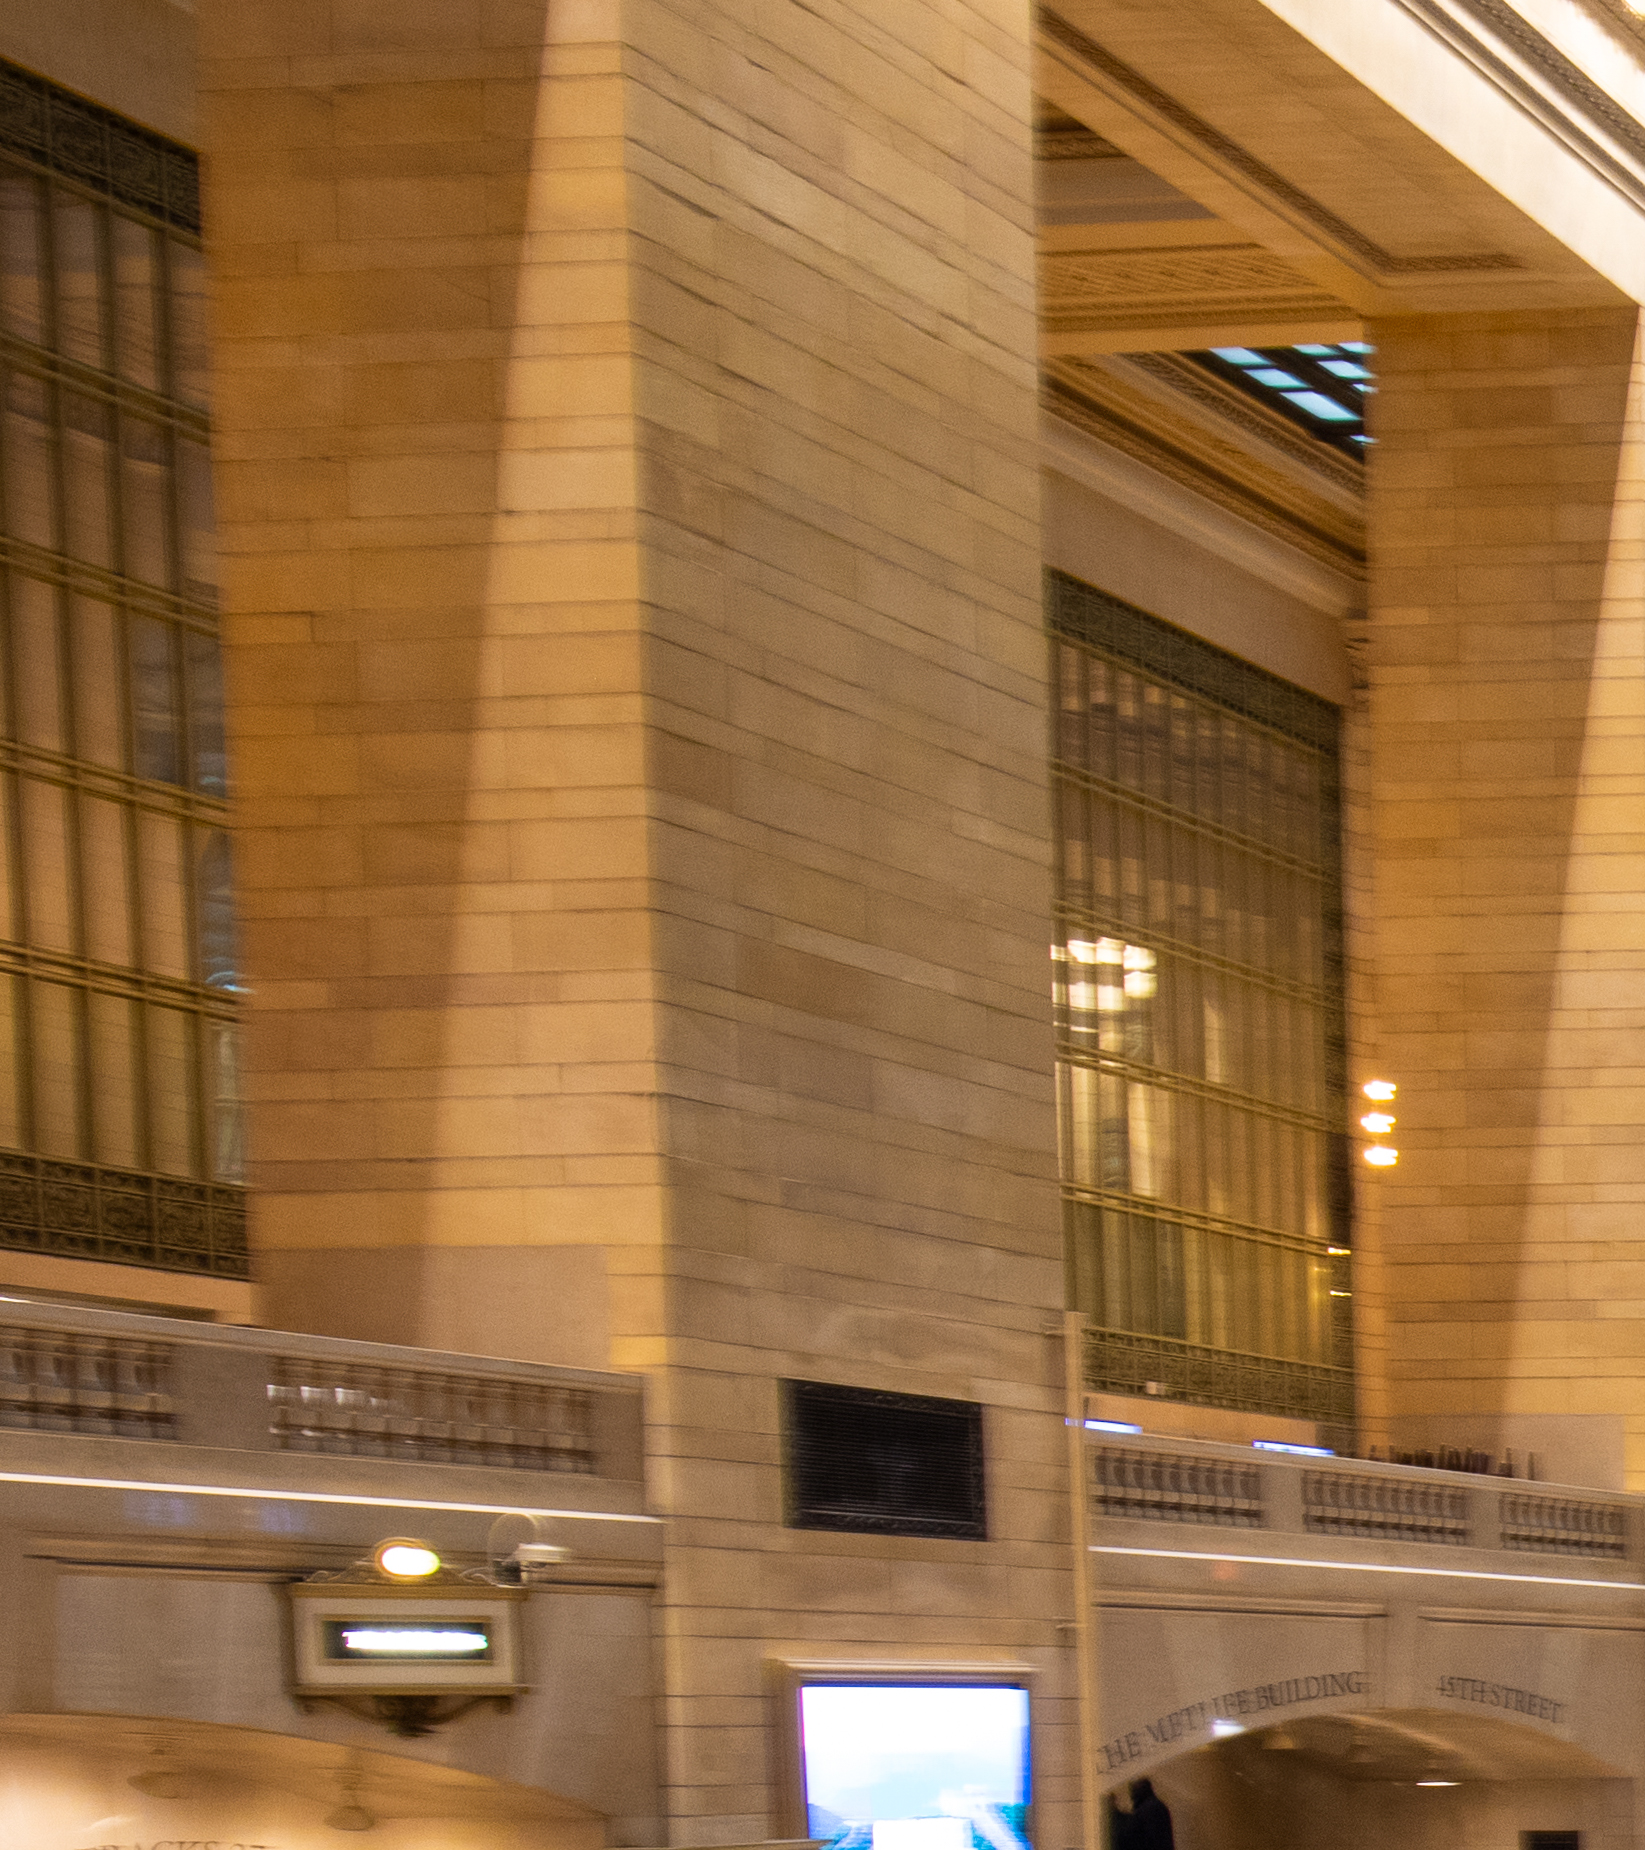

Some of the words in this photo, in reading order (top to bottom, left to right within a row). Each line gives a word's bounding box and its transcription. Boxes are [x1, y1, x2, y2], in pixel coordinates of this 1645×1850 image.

[1254, 1671, 1370, 1711] BUILDING
[1436, 1675, 1486, 1704] 45TH
[1488, 1683, 1567, 1724] STREET
